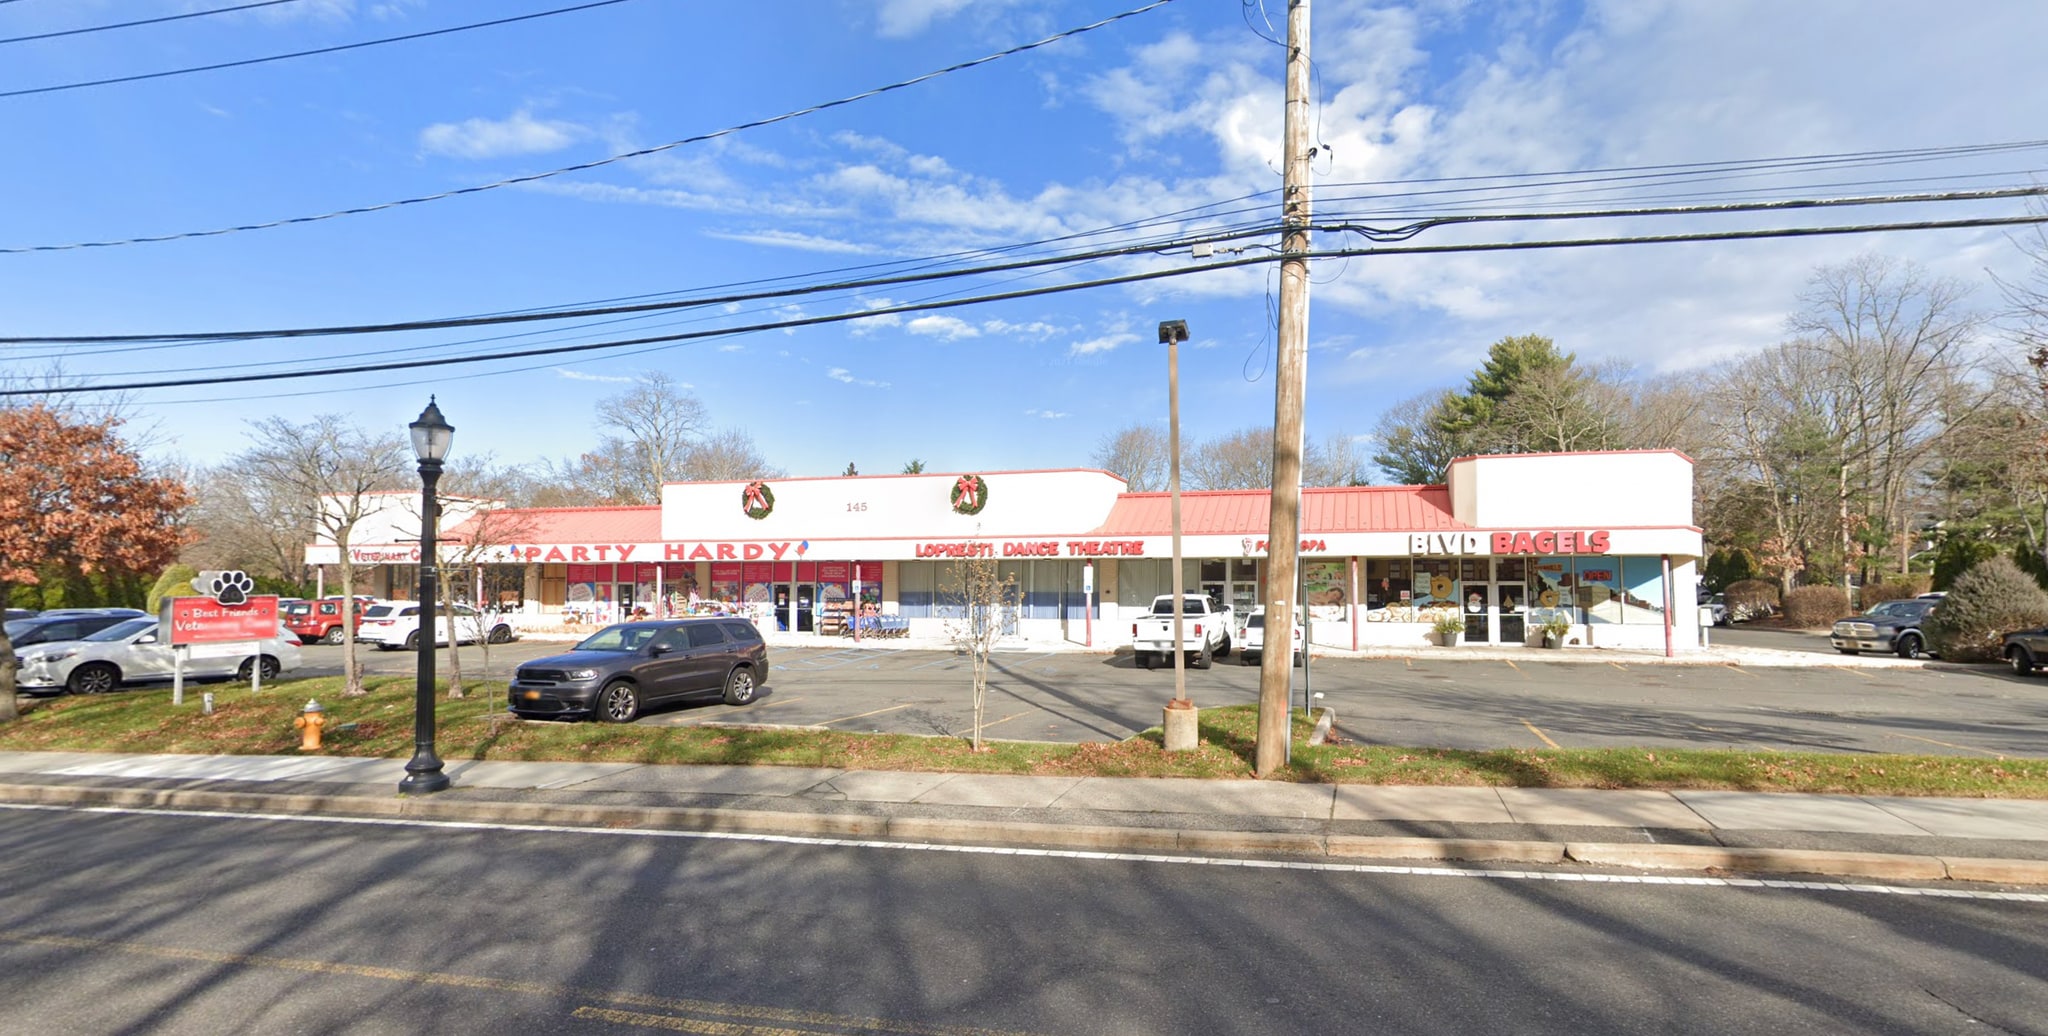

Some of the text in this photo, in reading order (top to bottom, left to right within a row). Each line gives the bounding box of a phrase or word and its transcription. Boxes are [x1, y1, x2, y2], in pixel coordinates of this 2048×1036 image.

[846, 502, 868, 512] 145
[1002, 541, 1060, 557] DANCE
[1067, 540, 1144, 556] THEATRE
[1409, 530, 1611, 554] BLVD BAGELS
[526, 541, 791, 563] PARTY HARDY
[1584, 571, 1611, 580] OPEN
[192, 607, 258, 618] Best Friends
